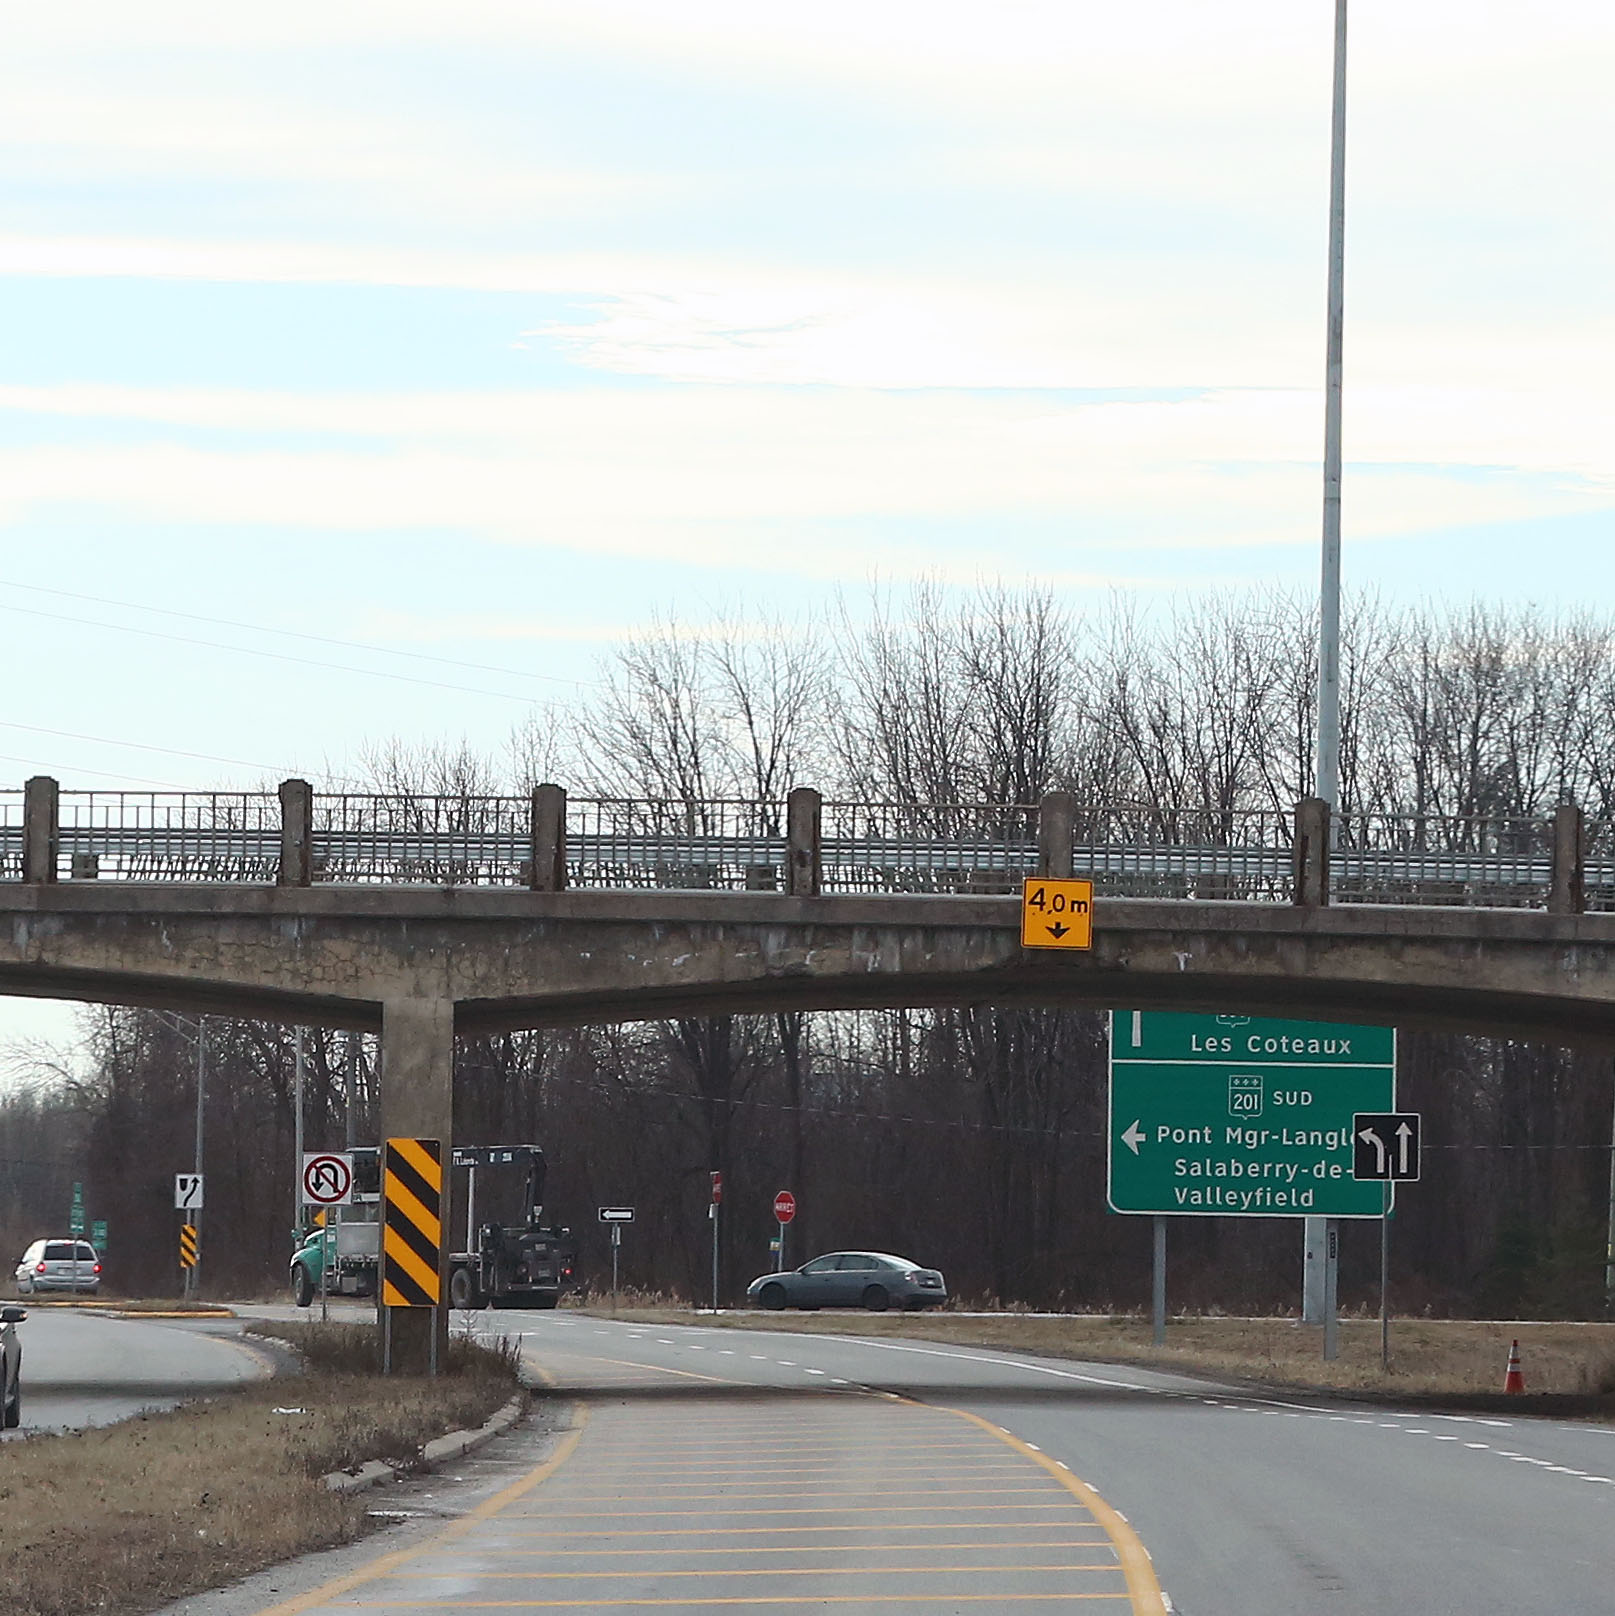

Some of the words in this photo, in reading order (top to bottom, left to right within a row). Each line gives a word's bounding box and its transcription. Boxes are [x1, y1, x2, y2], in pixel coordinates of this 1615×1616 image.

[1071, 900, 1088, 913] m
[1192, 1035, 1231, 1051] Les
[1248, 1036, 1350, 1053] Coteaux
[1234, 1094, 1257, 1109] 201
[1274, 1091, 1312, 1105] SUD
[1158, 1126, 1211, 1143] Pont
[1227, 1128, 1351, 1150] Mgr-Langl
[1176, 1159, 1351, 1182] Salaberry-de-
[1175, 1187, 1312, 1209] Valleyfield
